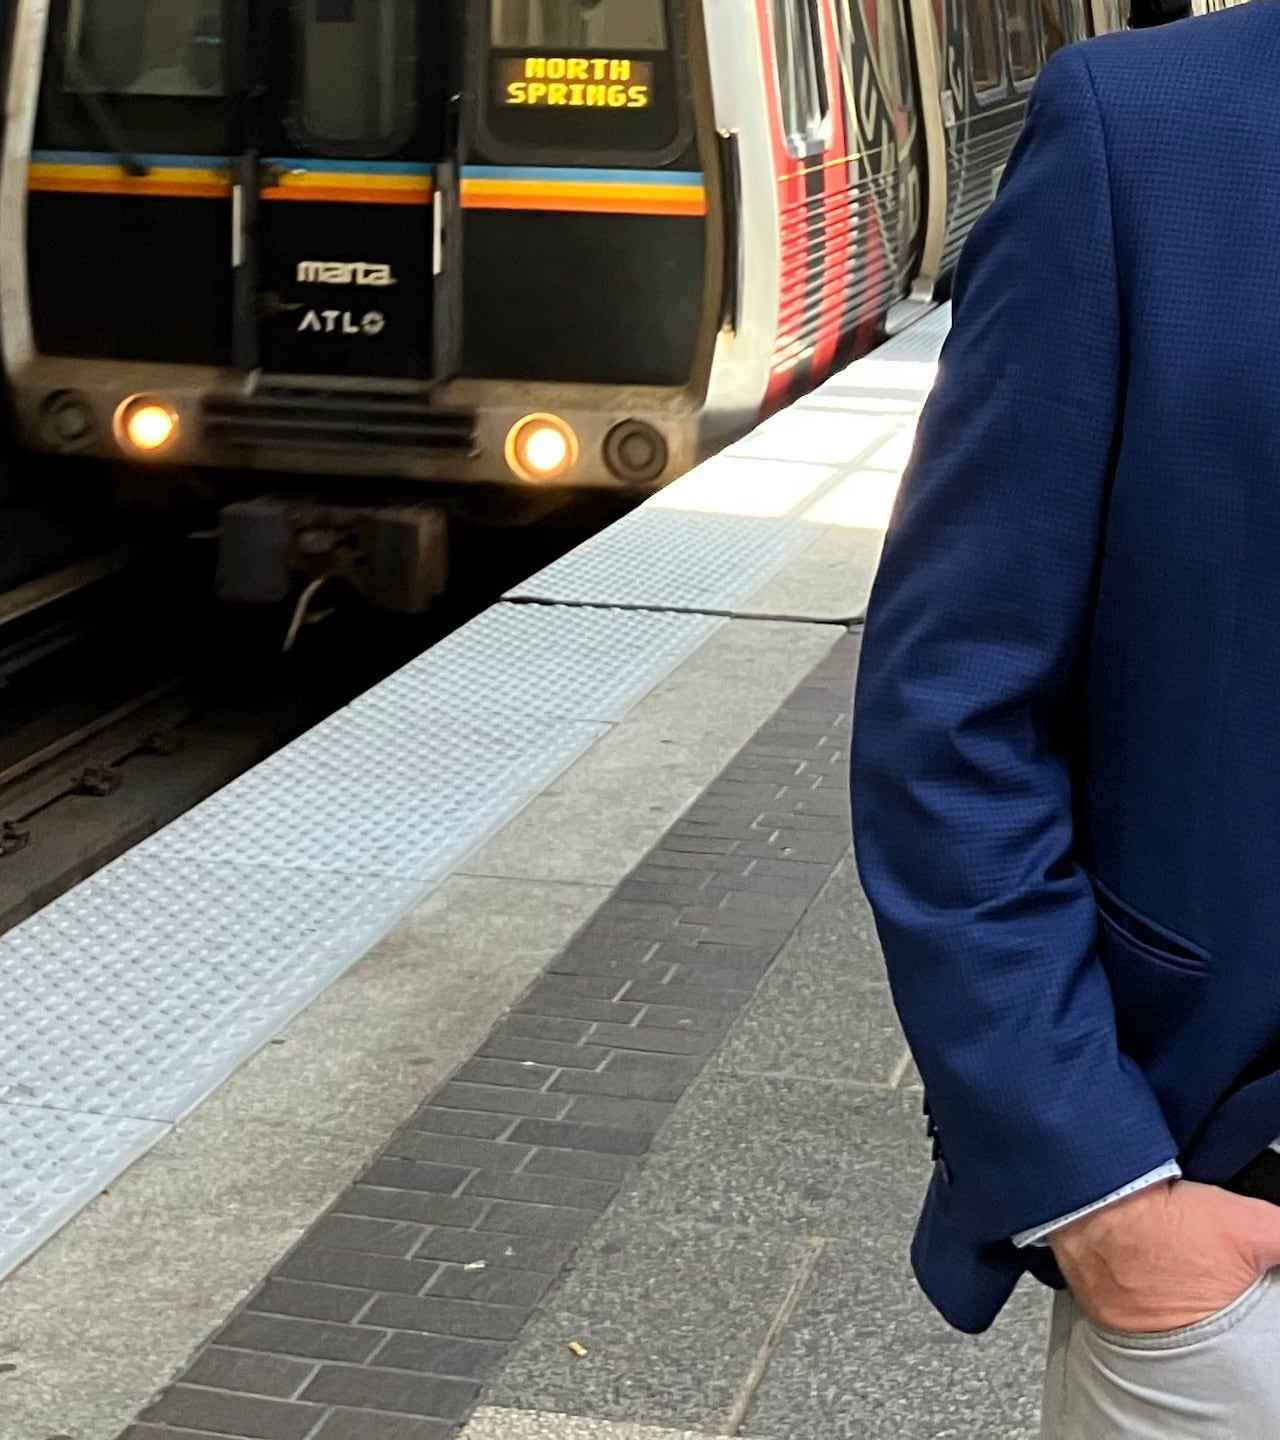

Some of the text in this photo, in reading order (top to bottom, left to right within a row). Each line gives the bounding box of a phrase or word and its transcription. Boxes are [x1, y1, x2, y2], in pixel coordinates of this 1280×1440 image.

[525, 57, 632, 81] NORTH
[505, 81, 649, 108] SPRINGS
[296, 260, 392, 286] marta
